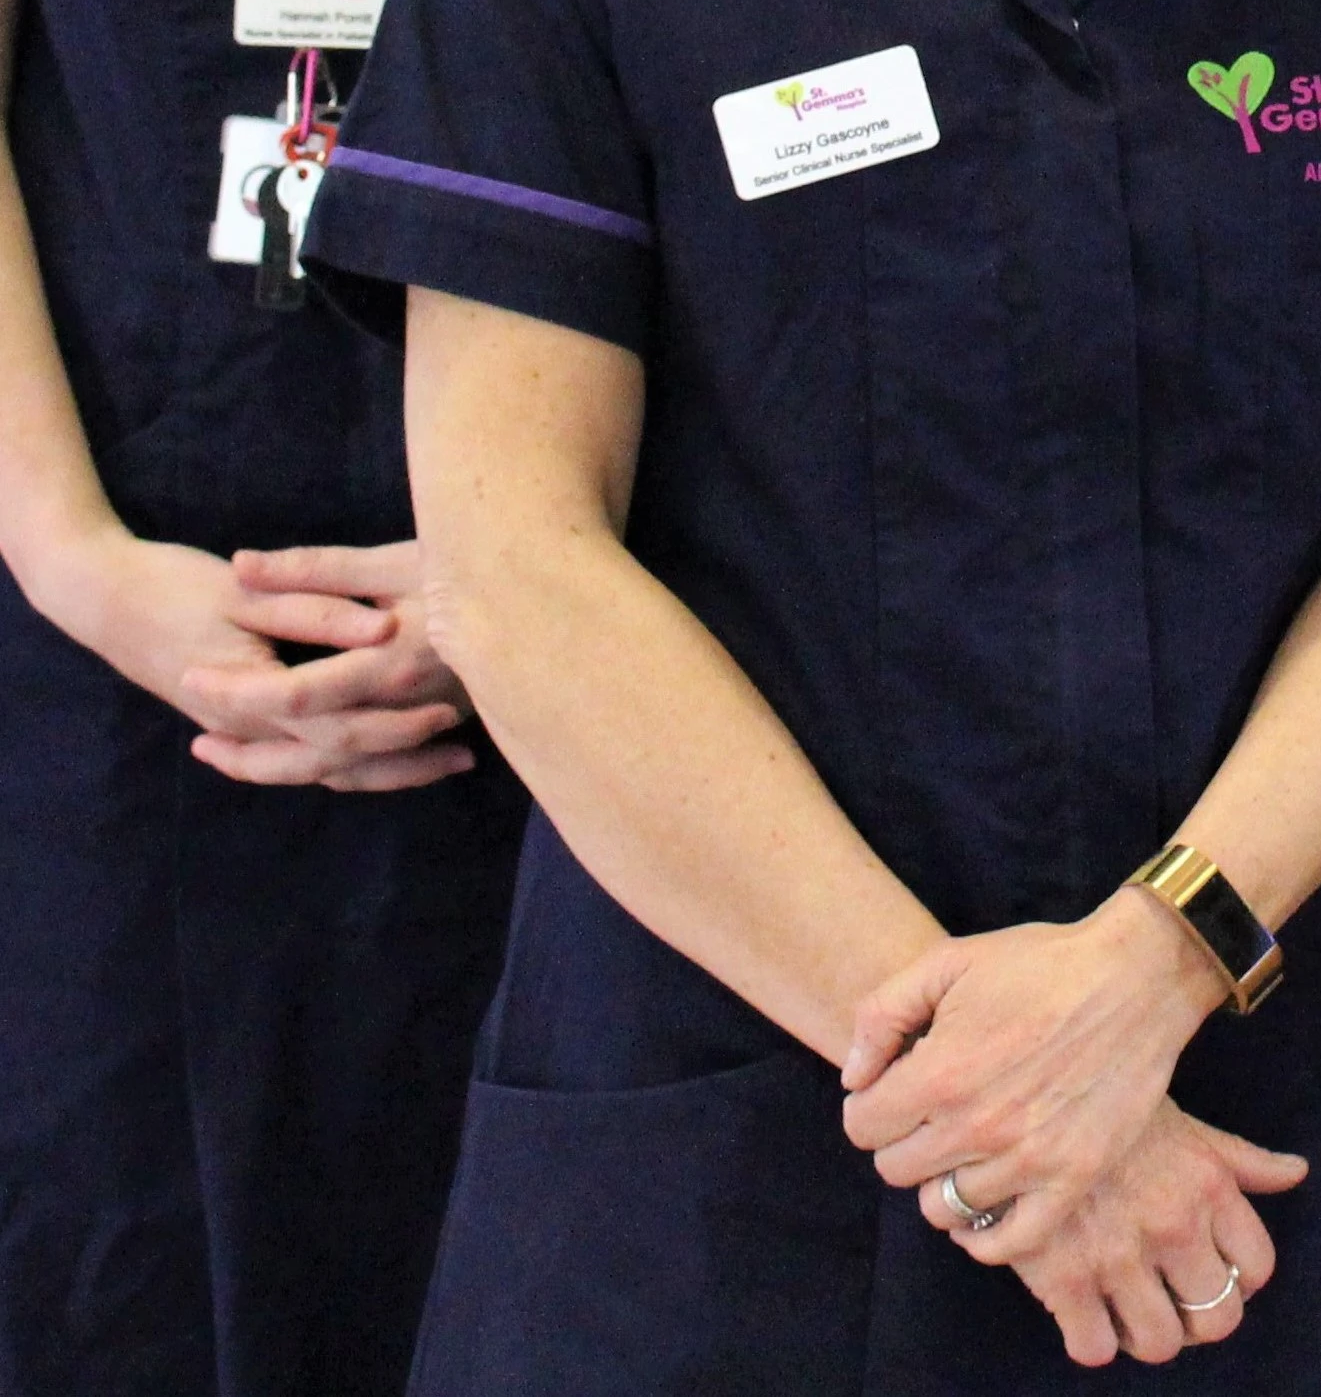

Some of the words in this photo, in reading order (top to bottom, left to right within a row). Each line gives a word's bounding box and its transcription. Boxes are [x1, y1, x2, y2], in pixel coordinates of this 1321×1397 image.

[802, 87, 865, 112] Gemma's
[754, 170, 789, 187] Senior
[792, 157, 832, 176] Clinical
[834, 148, 868, 163] Nurse
[870, 131, 923, 155] Specialist
[774, 138, 813, 160] Lizzy
[816, 118, 890, 148] Gascoyne
